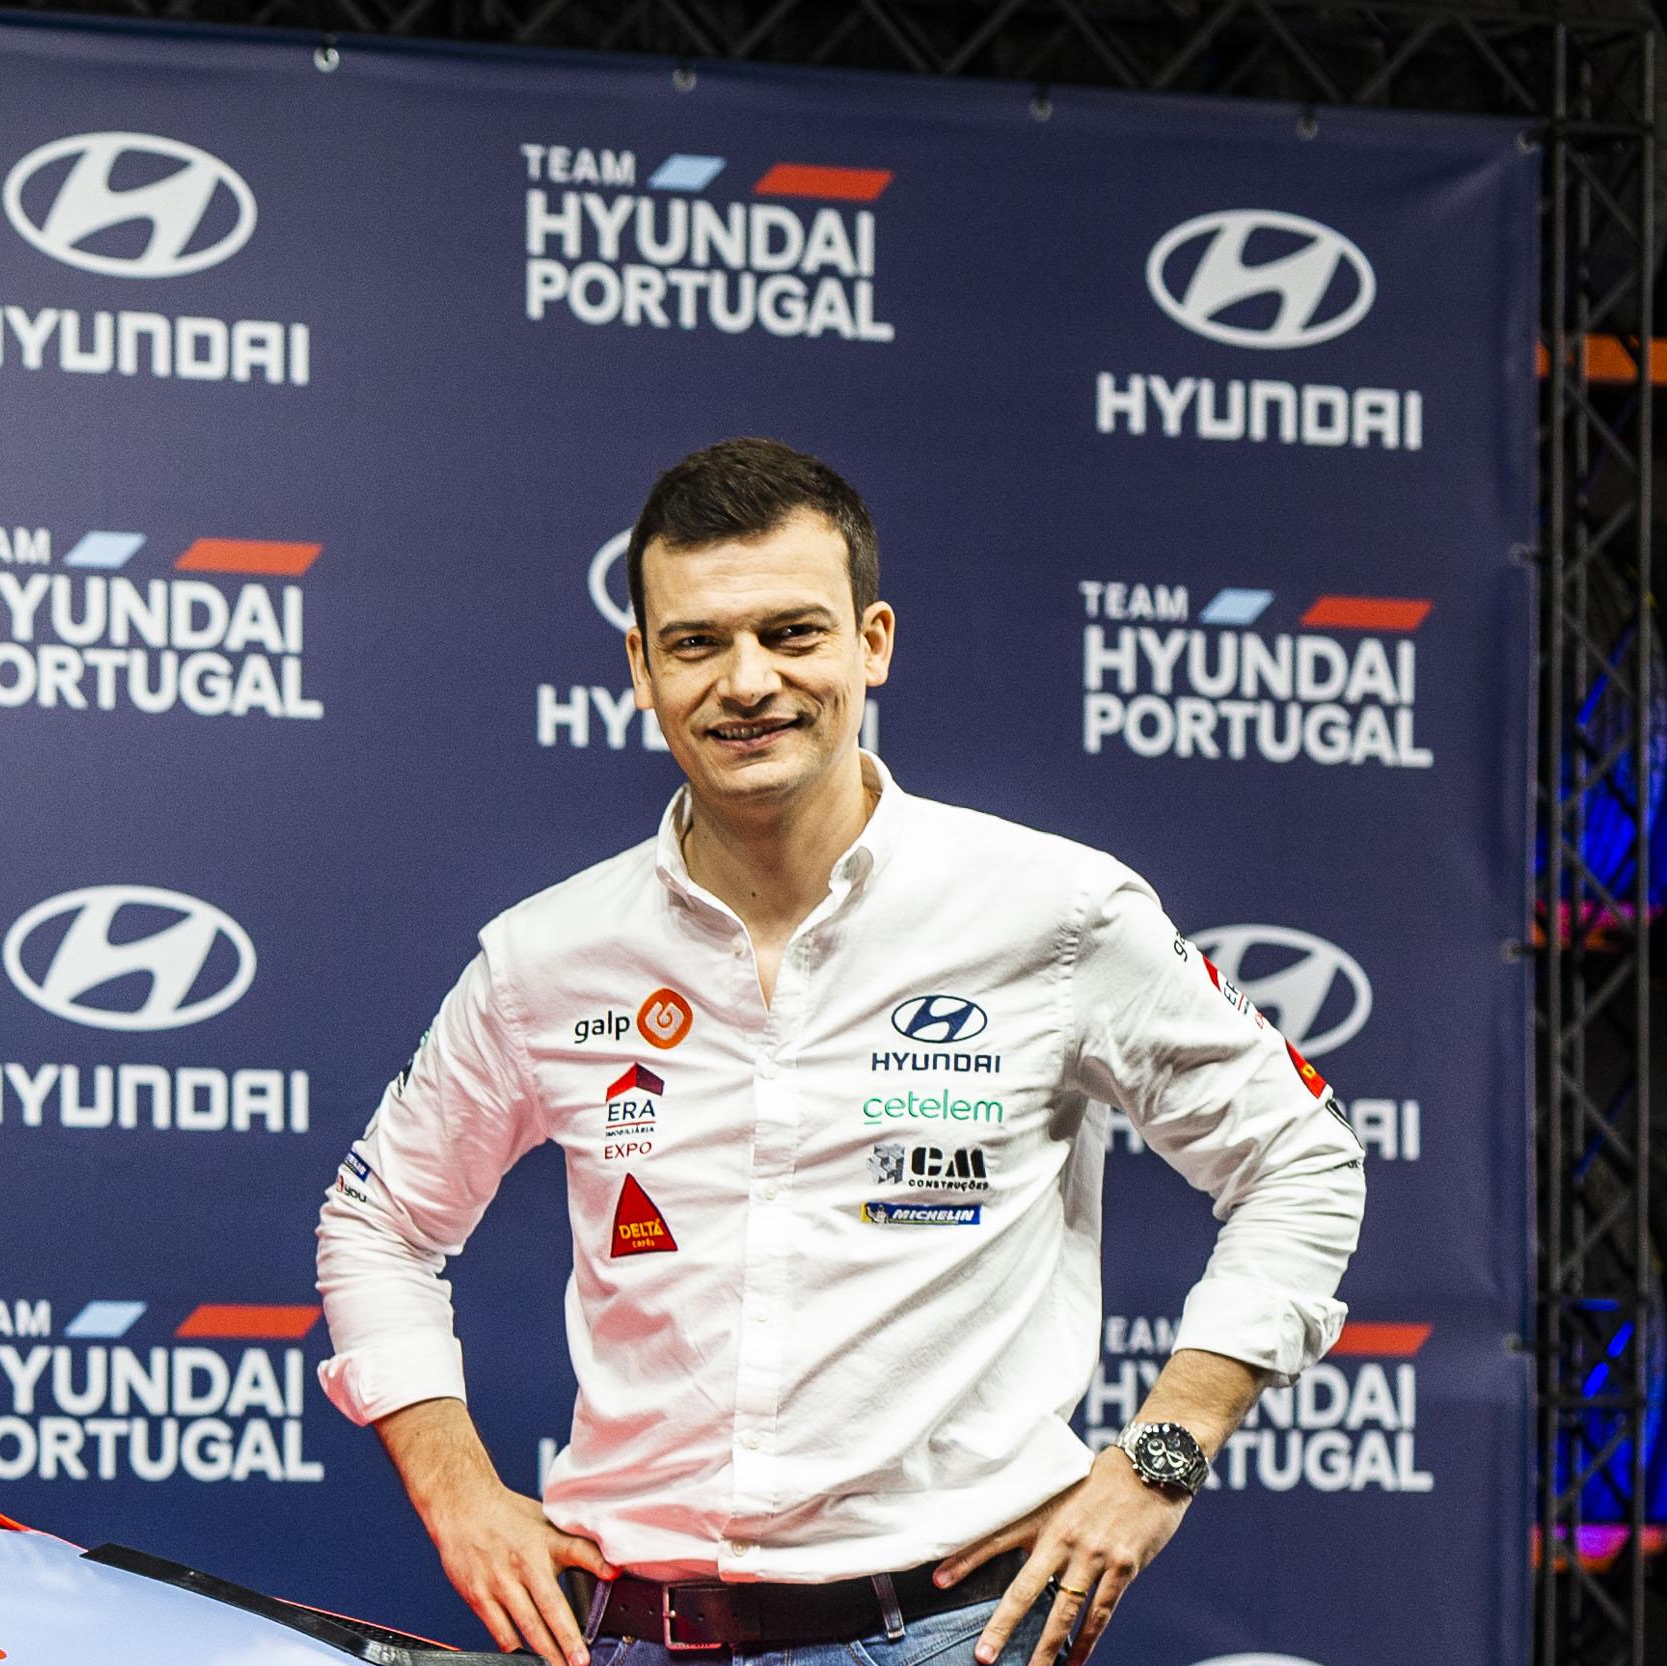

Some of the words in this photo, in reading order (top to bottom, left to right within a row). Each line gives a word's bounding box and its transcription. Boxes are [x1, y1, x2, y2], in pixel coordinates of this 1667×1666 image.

[520, 143, 635, 185] TEAM
[525, 191, 874, 276] HYUNDAI
[525, 259, 894, 341] PORTUGAL
[1096, 372, 1423, 451] HYUNDAI
[1080, 580, 1189, 624] TEAM
[1081, 626, 1416, 707] HYUNDAI
[1081, 694, 1433, 767] PORTUGAL
[574, 1011, 630, 1044] galp
[871, 1052, 1001, 1073] HYUNDAI
[607, 1099, 656, 1122] ERA
[604, 1141, 652, 1160] EXPO
[892, 1208, 976, 1221] MICHELIN
